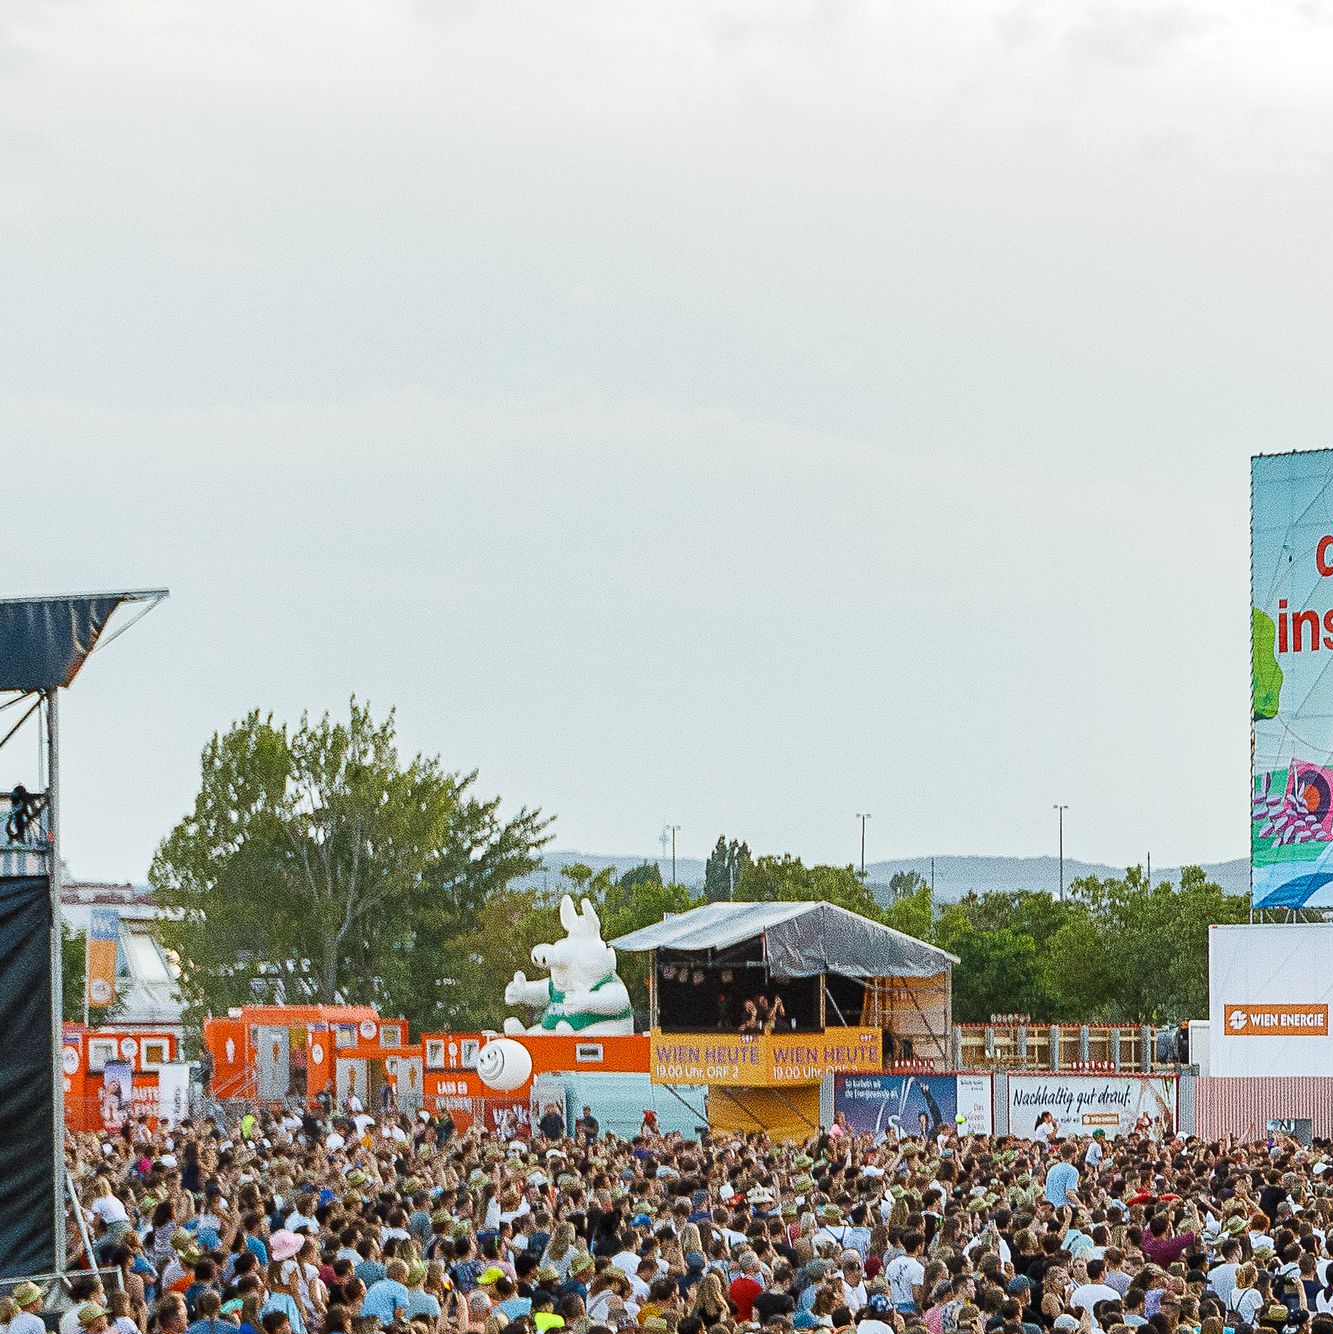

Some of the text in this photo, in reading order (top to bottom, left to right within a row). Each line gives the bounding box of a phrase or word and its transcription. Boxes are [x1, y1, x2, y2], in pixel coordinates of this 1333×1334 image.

[1249, 1012, 1325, 1028] WIEN ENERGIE
[656, 1045, 759, 1064] WIEN HEUTE
[773, 1044, 880, 1064] WIEN HEUTE
[656, 1066, 683, 1079] 19.00
[707, 1066, 727, 1079] ORF
[773, 1066, 800, 1080] 19.00
[1013, 1086, 1074, 1113] Nachhaltig
[1077, 1088, 1098, 1113] gut
